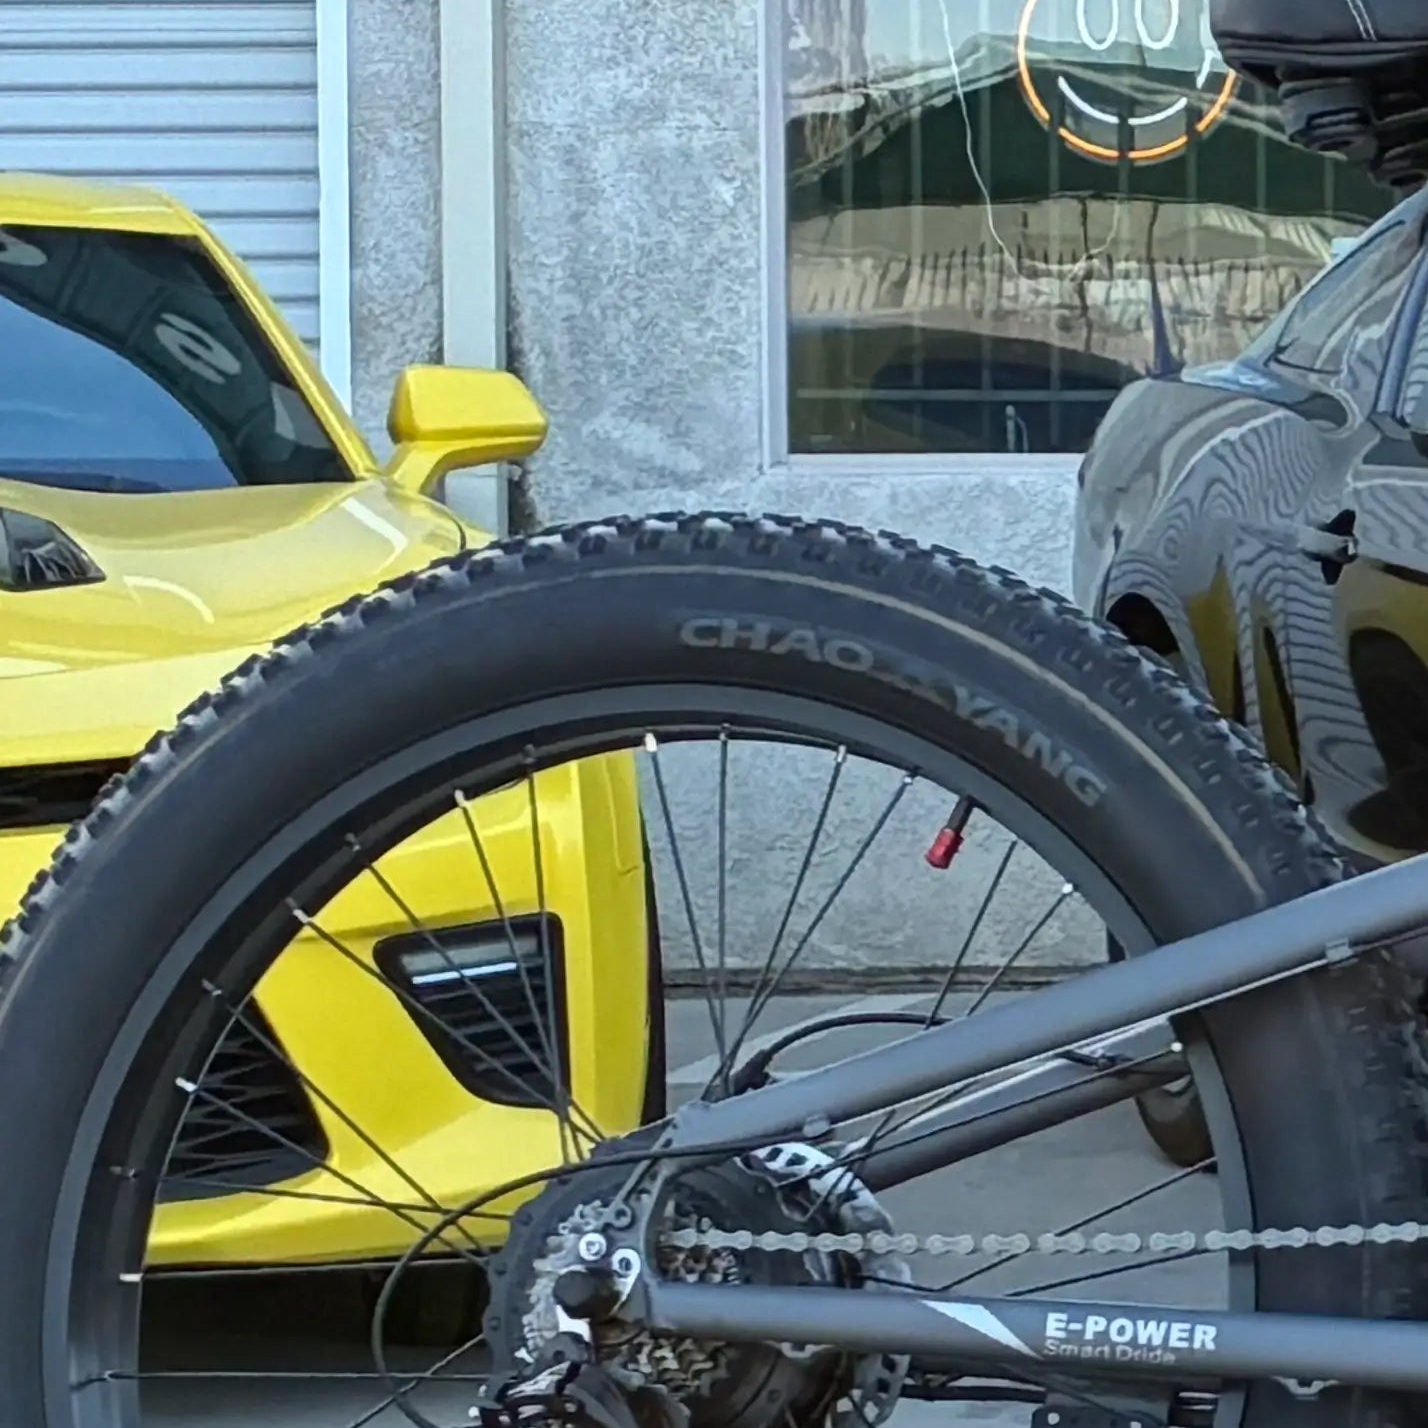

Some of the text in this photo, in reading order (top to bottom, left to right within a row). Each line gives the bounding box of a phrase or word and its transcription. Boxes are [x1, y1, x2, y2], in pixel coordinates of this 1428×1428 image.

[680, 617, 1108, 809] CHAO YANG
[1044, 1338, 1110, 1360] Smart
[1045, 1312, 1217, 1351] E-POWER
